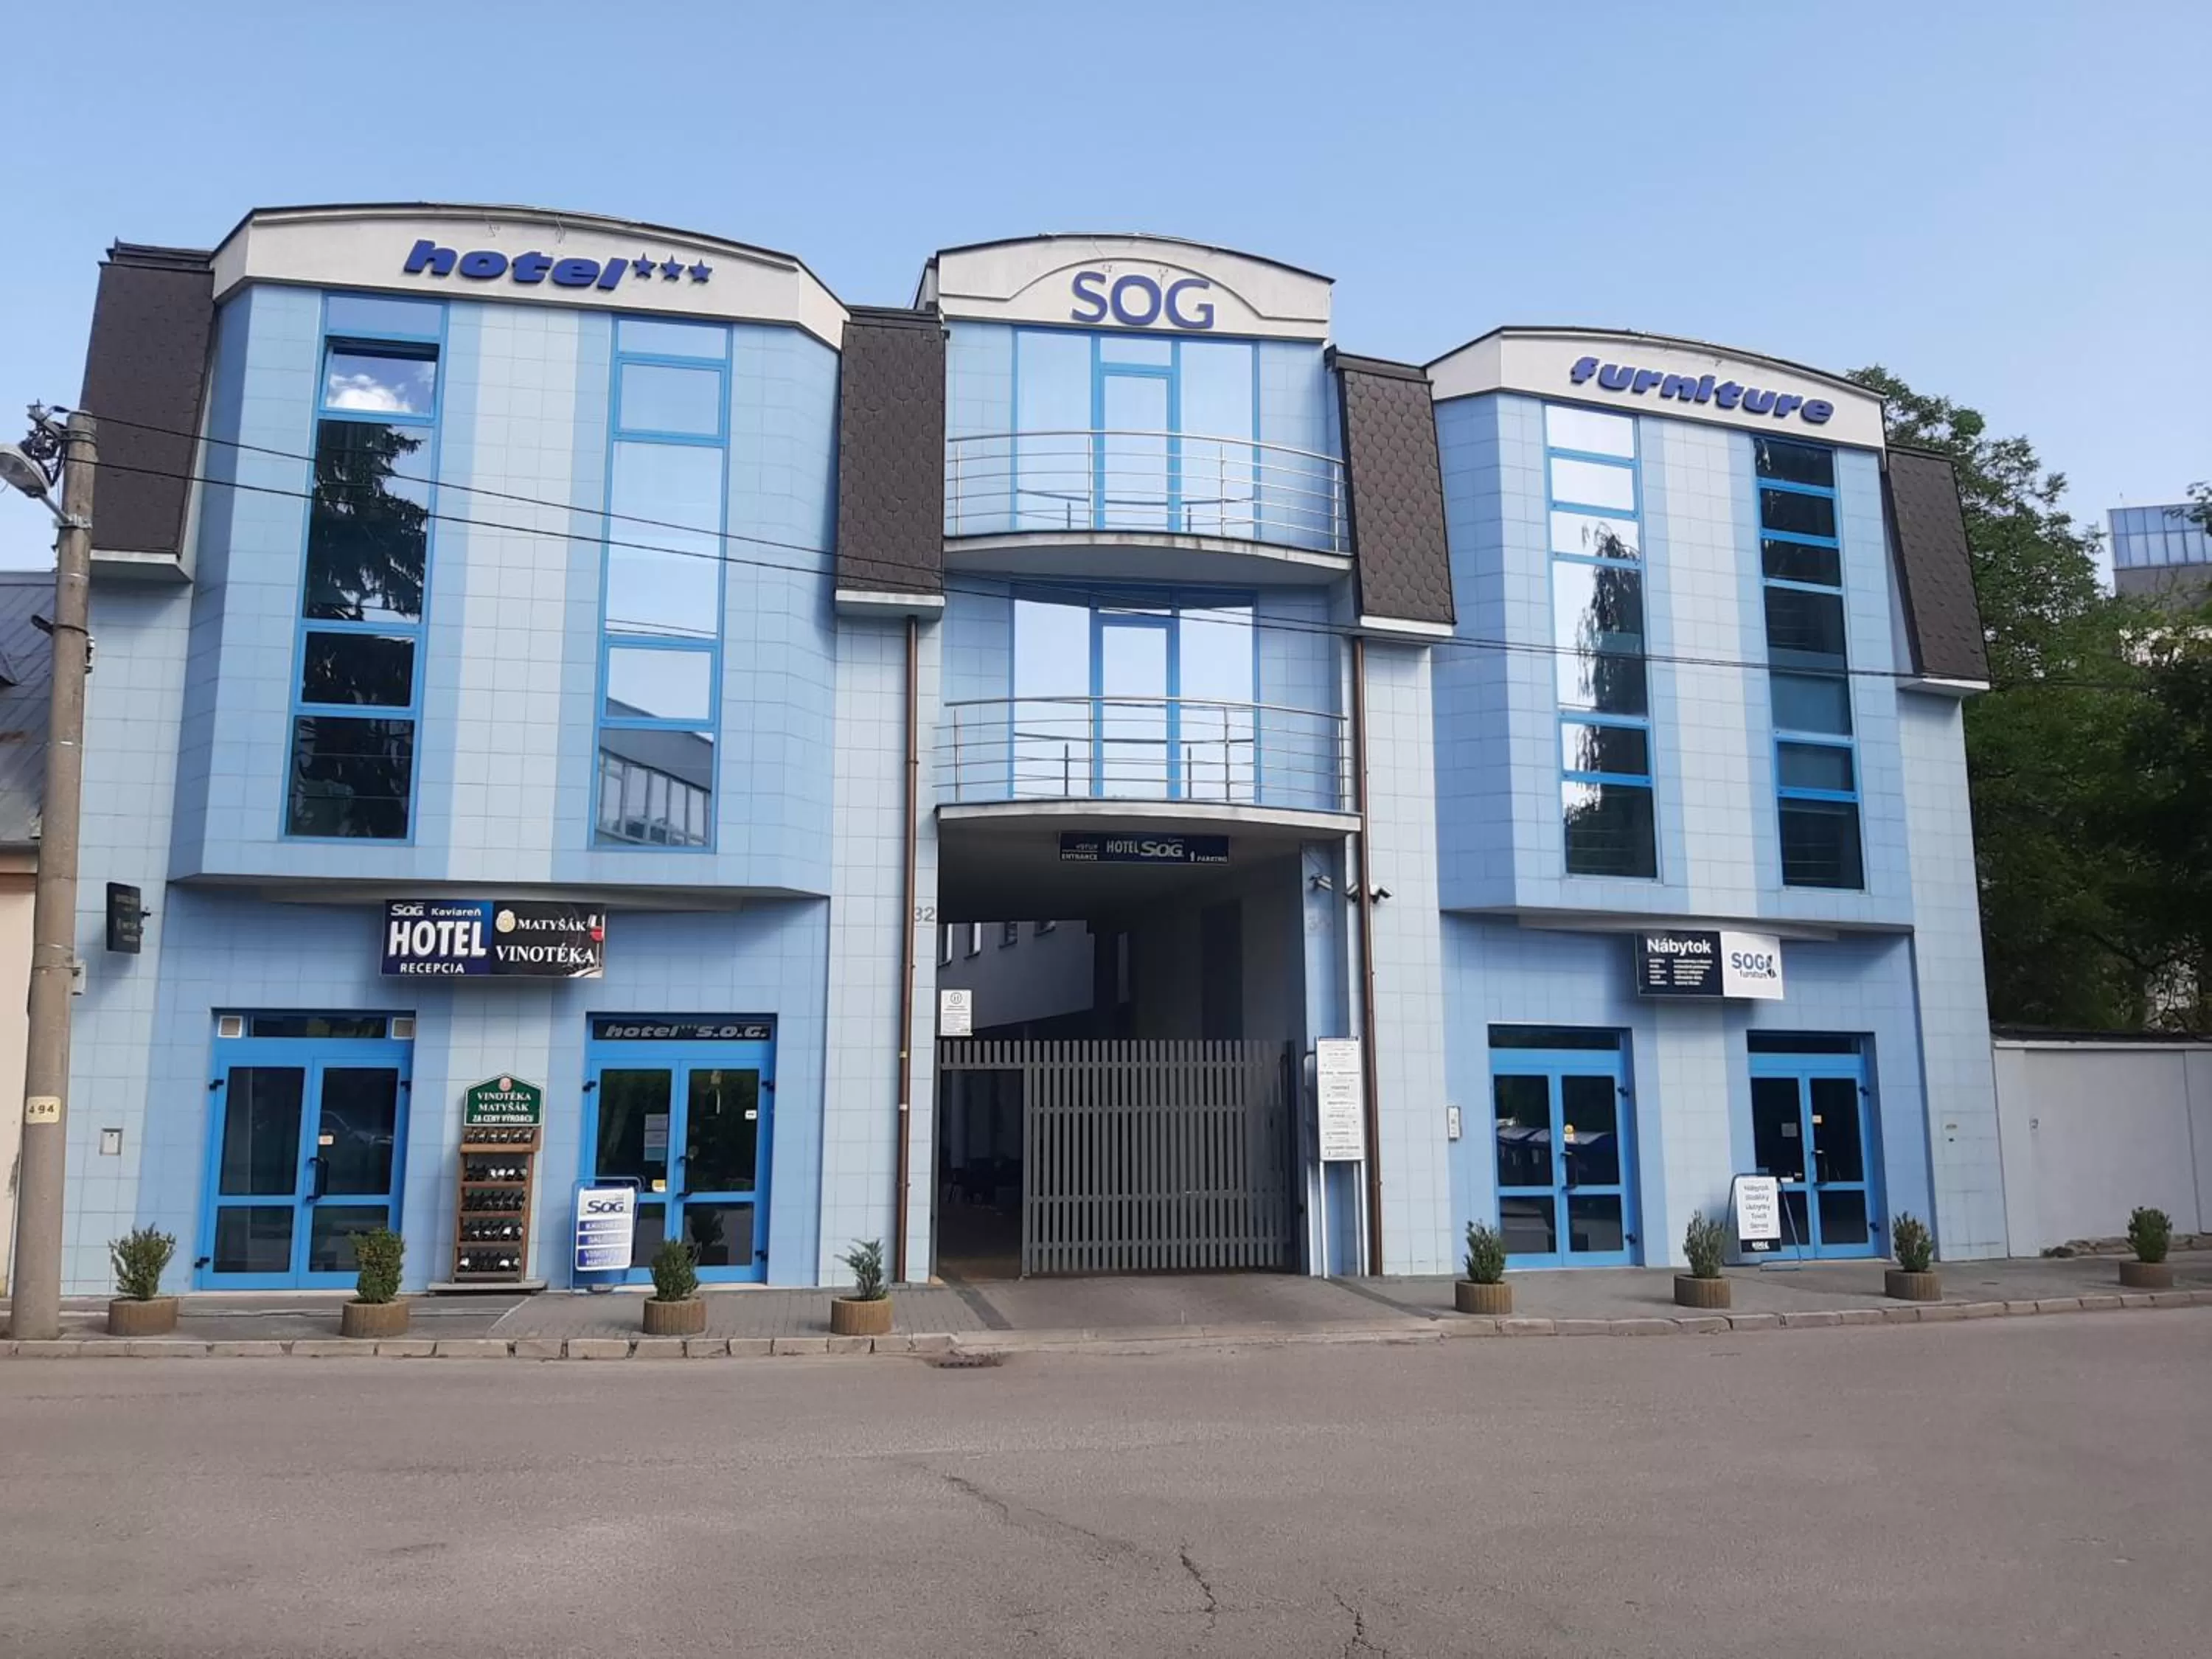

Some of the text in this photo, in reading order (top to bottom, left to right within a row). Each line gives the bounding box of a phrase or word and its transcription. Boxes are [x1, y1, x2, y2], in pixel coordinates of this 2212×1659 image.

[403, 239, 629, 291] hotel
[1071, 271, 1214, 329] SOG
[1570, 356, 1834, 423] furniture
[1107, 839, 1139, 853] HOTEL
[1197, 855, 1228, 863] PARKING
[915, 907, 936, 922] 32
[518, 917, 587, 931] MATYŠÁK
[389, 920, 487, 958] HOTEL
[495, 942, 596, 964] VINOTÉKA
[1647, 937, 1711, 956] Nábytok
[400, 962, 465, 974] RECEPCIA
[605, 1024, 678, 1038] hotel
[477, 1090, 532, 1101] VINOTÉKA
[478, 1102, 529, 1112] MATYŠÁK
[586, 1200, 625, 1214] SOG
